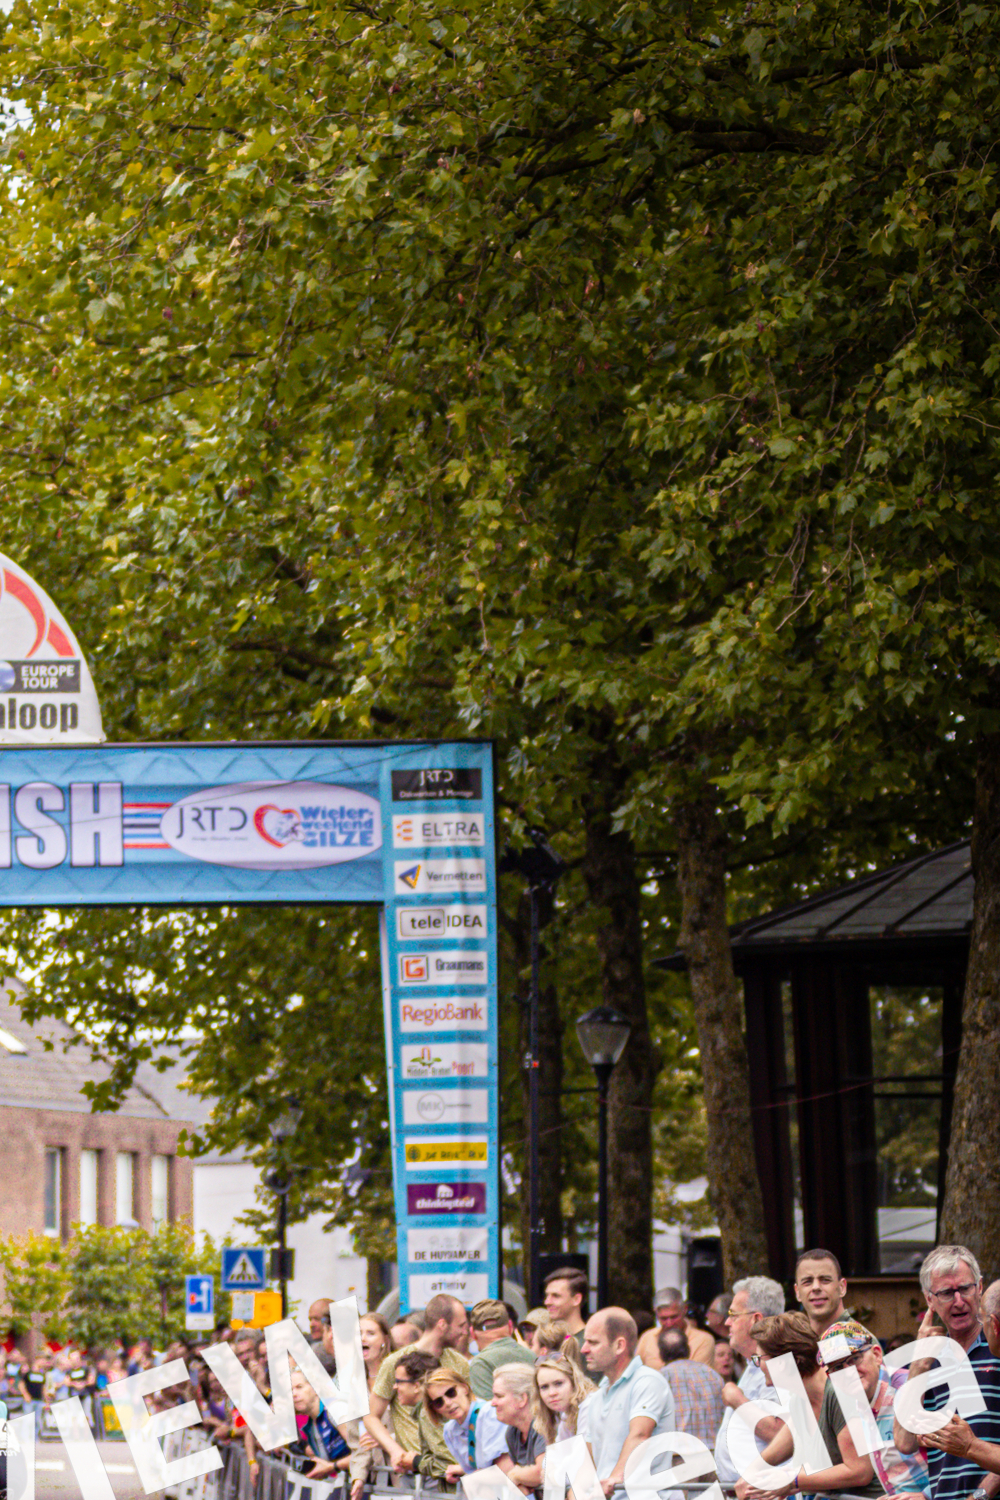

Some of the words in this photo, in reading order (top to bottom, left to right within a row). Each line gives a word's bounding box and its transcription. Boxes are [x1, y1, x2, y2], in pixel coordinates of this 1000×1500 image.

[20, 664, 75, 678] EUROPE
[21, 676, 59, 690] TOUR
[300, 805, 374, 820] Wieler-
[422, 822, 480, 837] ELTRA
[301, 831, 374, 848] GILZE
[426, 872, 483, 881] Vermetten
[402, 1002, 483, 1026] RegioBank
